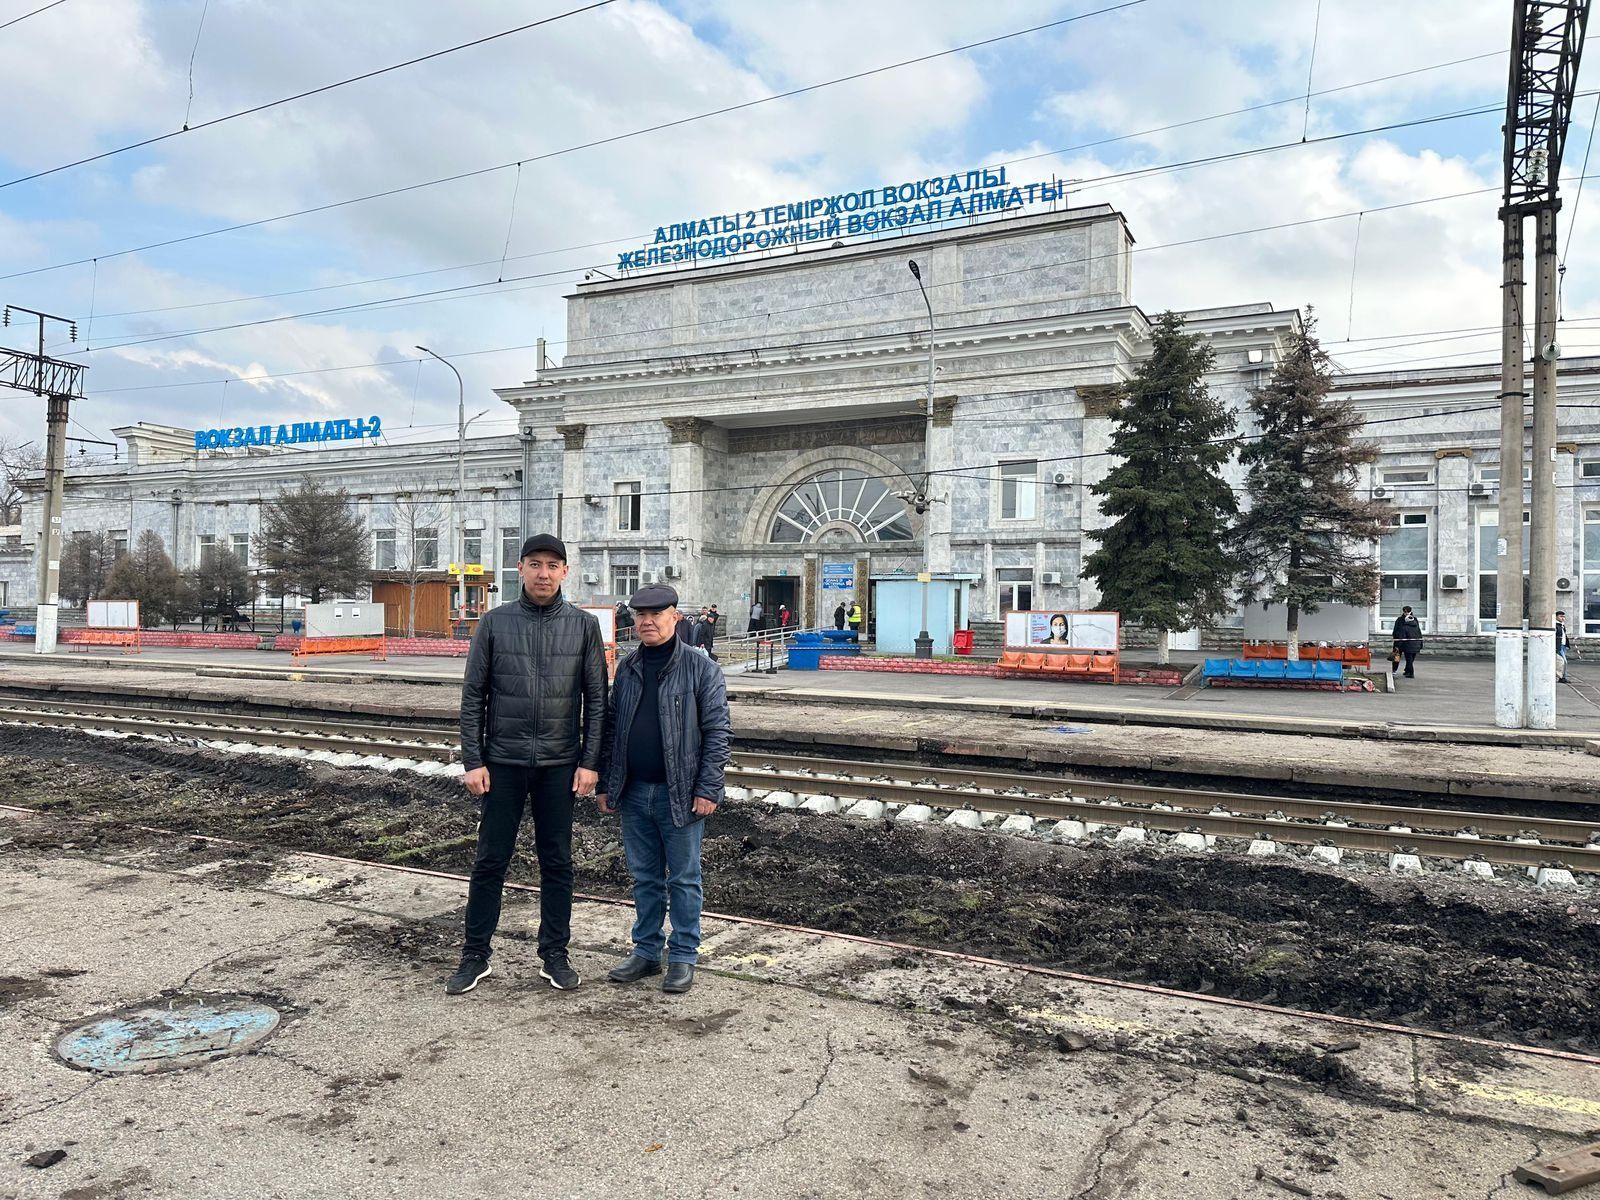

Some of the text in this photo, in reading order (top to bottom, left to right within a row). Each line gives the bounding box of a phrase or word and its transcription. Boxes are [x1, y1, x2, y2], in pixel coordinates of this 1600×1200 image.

[617, 179, 1063, 270] ЖЕЛЕЗНОДОРОЖНЫЙ ВОКЗАЛ АЛМАТЫ
[654, 166, 1006, 244] АЛМАТЫ 2 ТЕМІРЖОЛ ВОКЗАЛЫ
[194, 415, 381, 450] ВОКЗАЛ АЛМАТЫ-2
